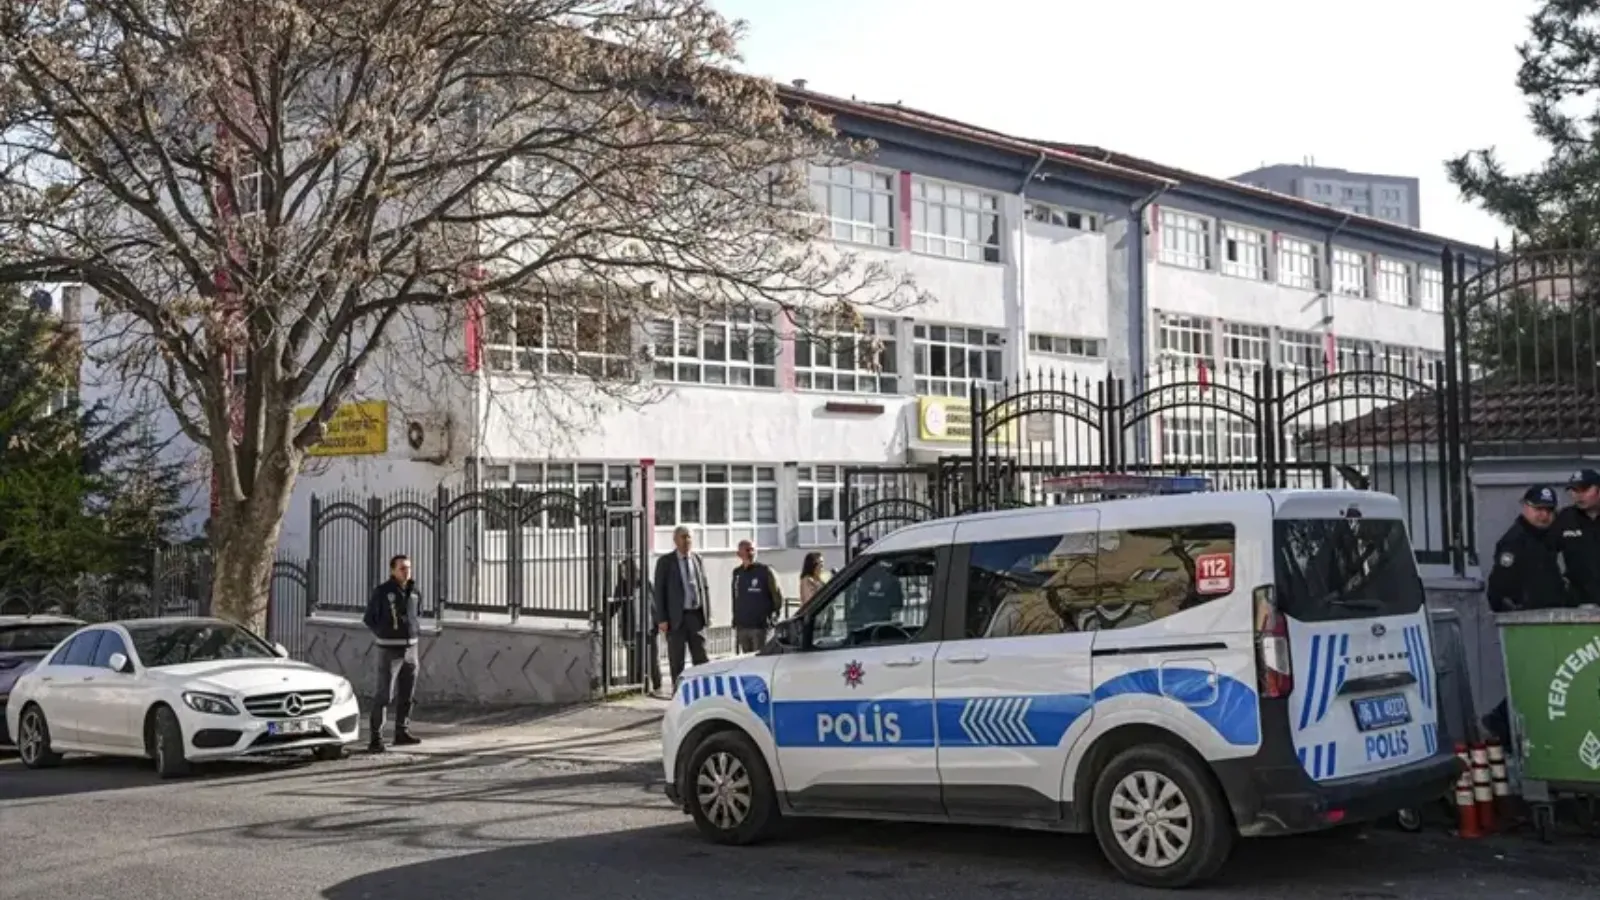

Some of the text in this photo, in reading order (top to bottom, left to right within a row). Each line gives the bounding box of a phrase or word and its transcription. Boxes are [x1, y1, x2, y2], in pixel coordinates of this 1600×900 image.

[1202, 558, 1227, 577] 112
[816, 703, 902, 743] POLİS
[1365, 729, 1409, 762] POLİS
